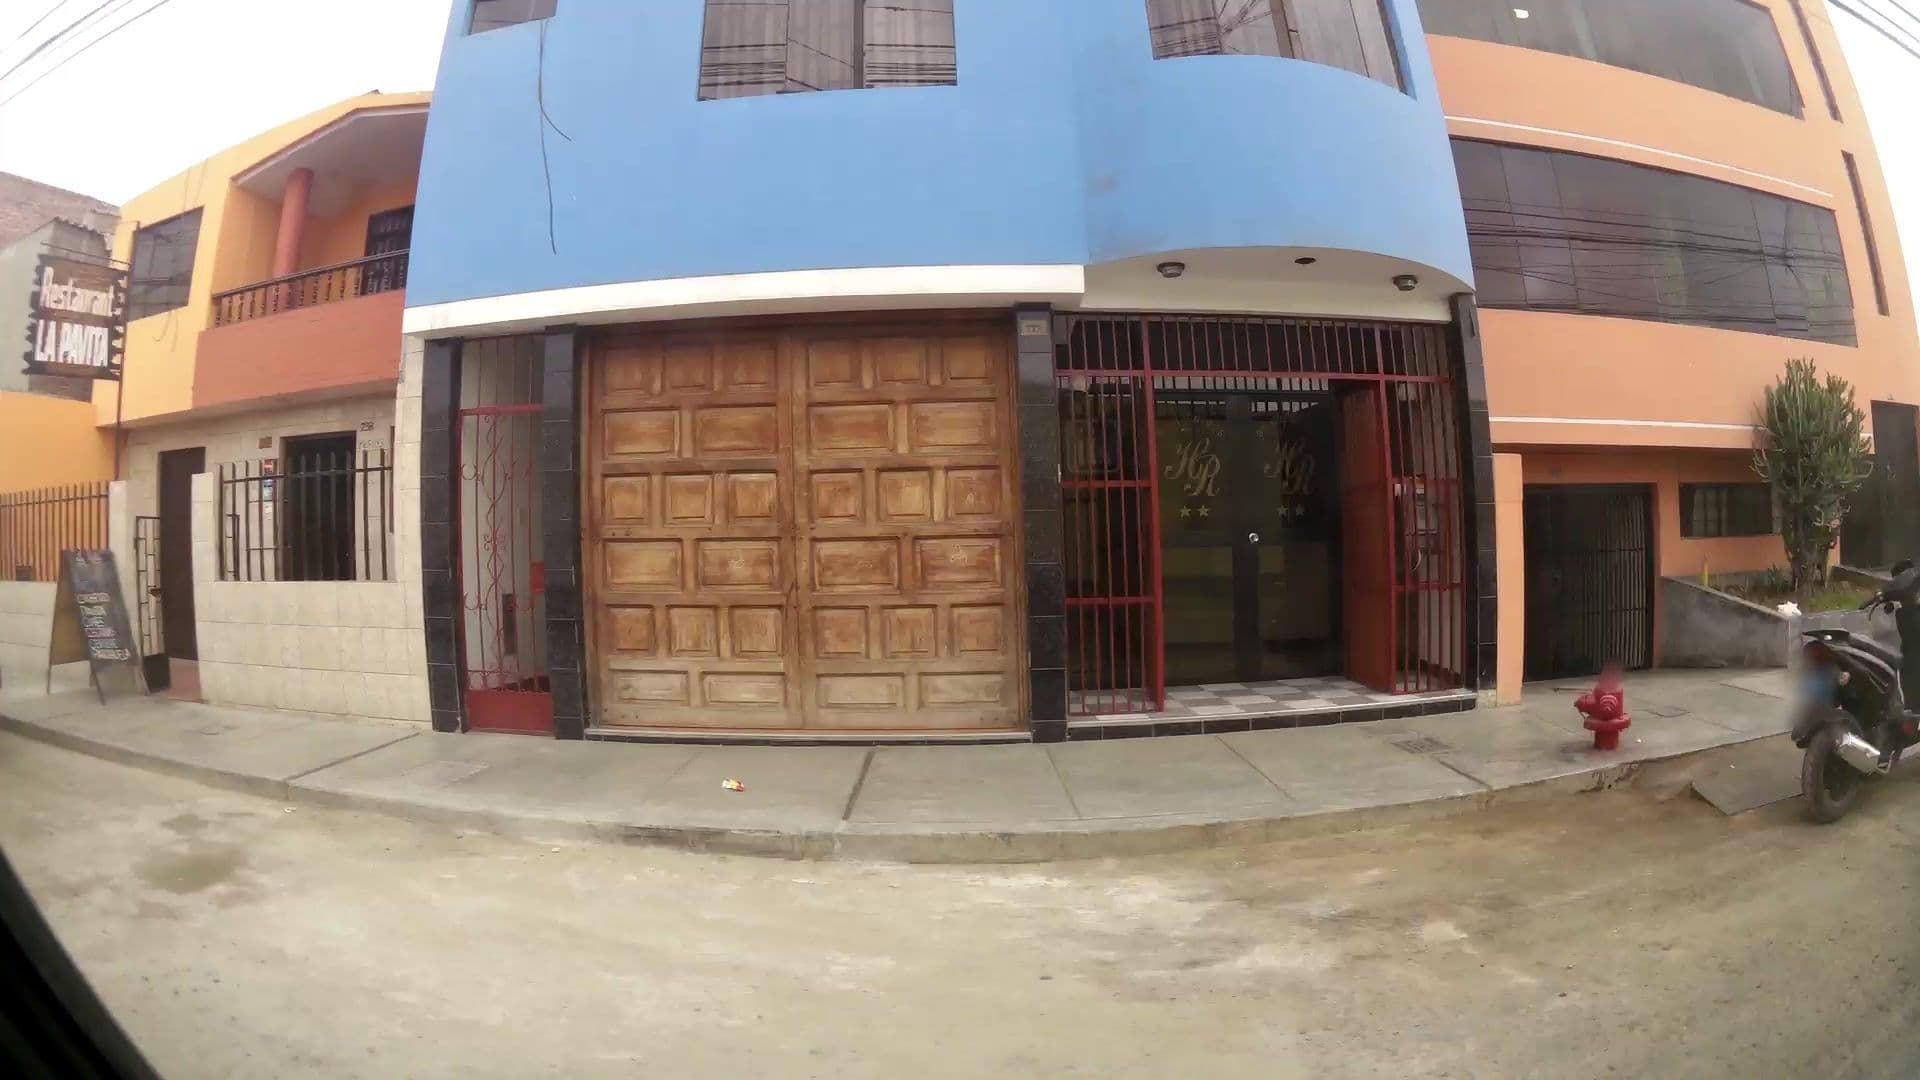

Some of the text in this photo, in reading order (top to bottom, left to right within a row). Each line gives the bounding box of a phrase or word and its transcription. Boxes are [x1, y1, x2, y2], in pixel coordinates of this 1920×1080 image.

[41, 266, 114, 317] Restaurant
[35, 319, 108, 367] LA PAVITA
